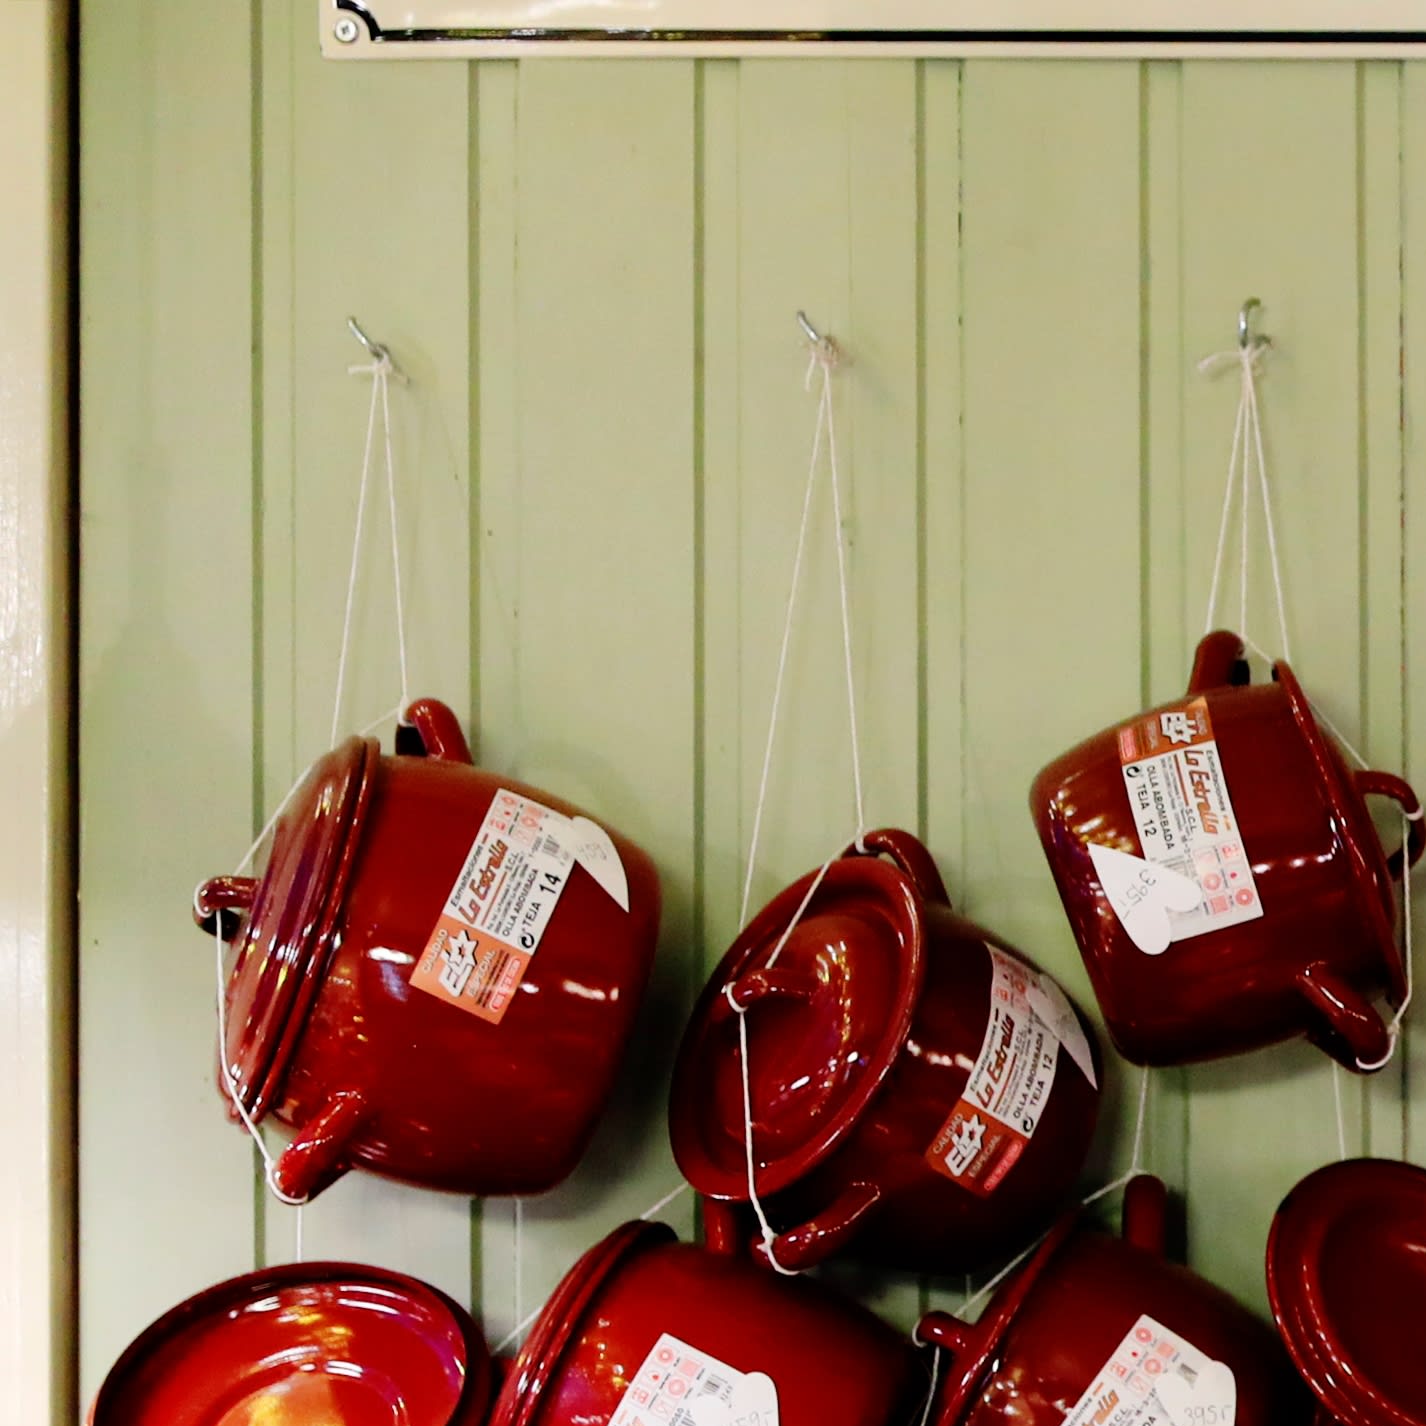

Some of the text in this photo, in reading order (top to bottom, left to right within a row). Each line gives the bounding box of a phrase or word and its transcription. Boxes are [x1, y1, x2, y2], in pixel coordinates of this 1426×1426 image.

[1135, 784, 1157, 837] TEJA 12
[1145, 765, 1175, 848] OLLA ABOMBADA
[1182, 746, 1223, 835] La Estrella
[467, 838, 509, 898] Estrella
[454, 896, 482, 925] La
[501, 913, 517, 936] OLLA
[522, 871, 562, 927] TEJA 14
[972, 1016, 1017, 1108] La Estrella
[1029, 1052, 1055, 1106] TEJA 12
[1012, 1092, 1027, 1118] OLLA
